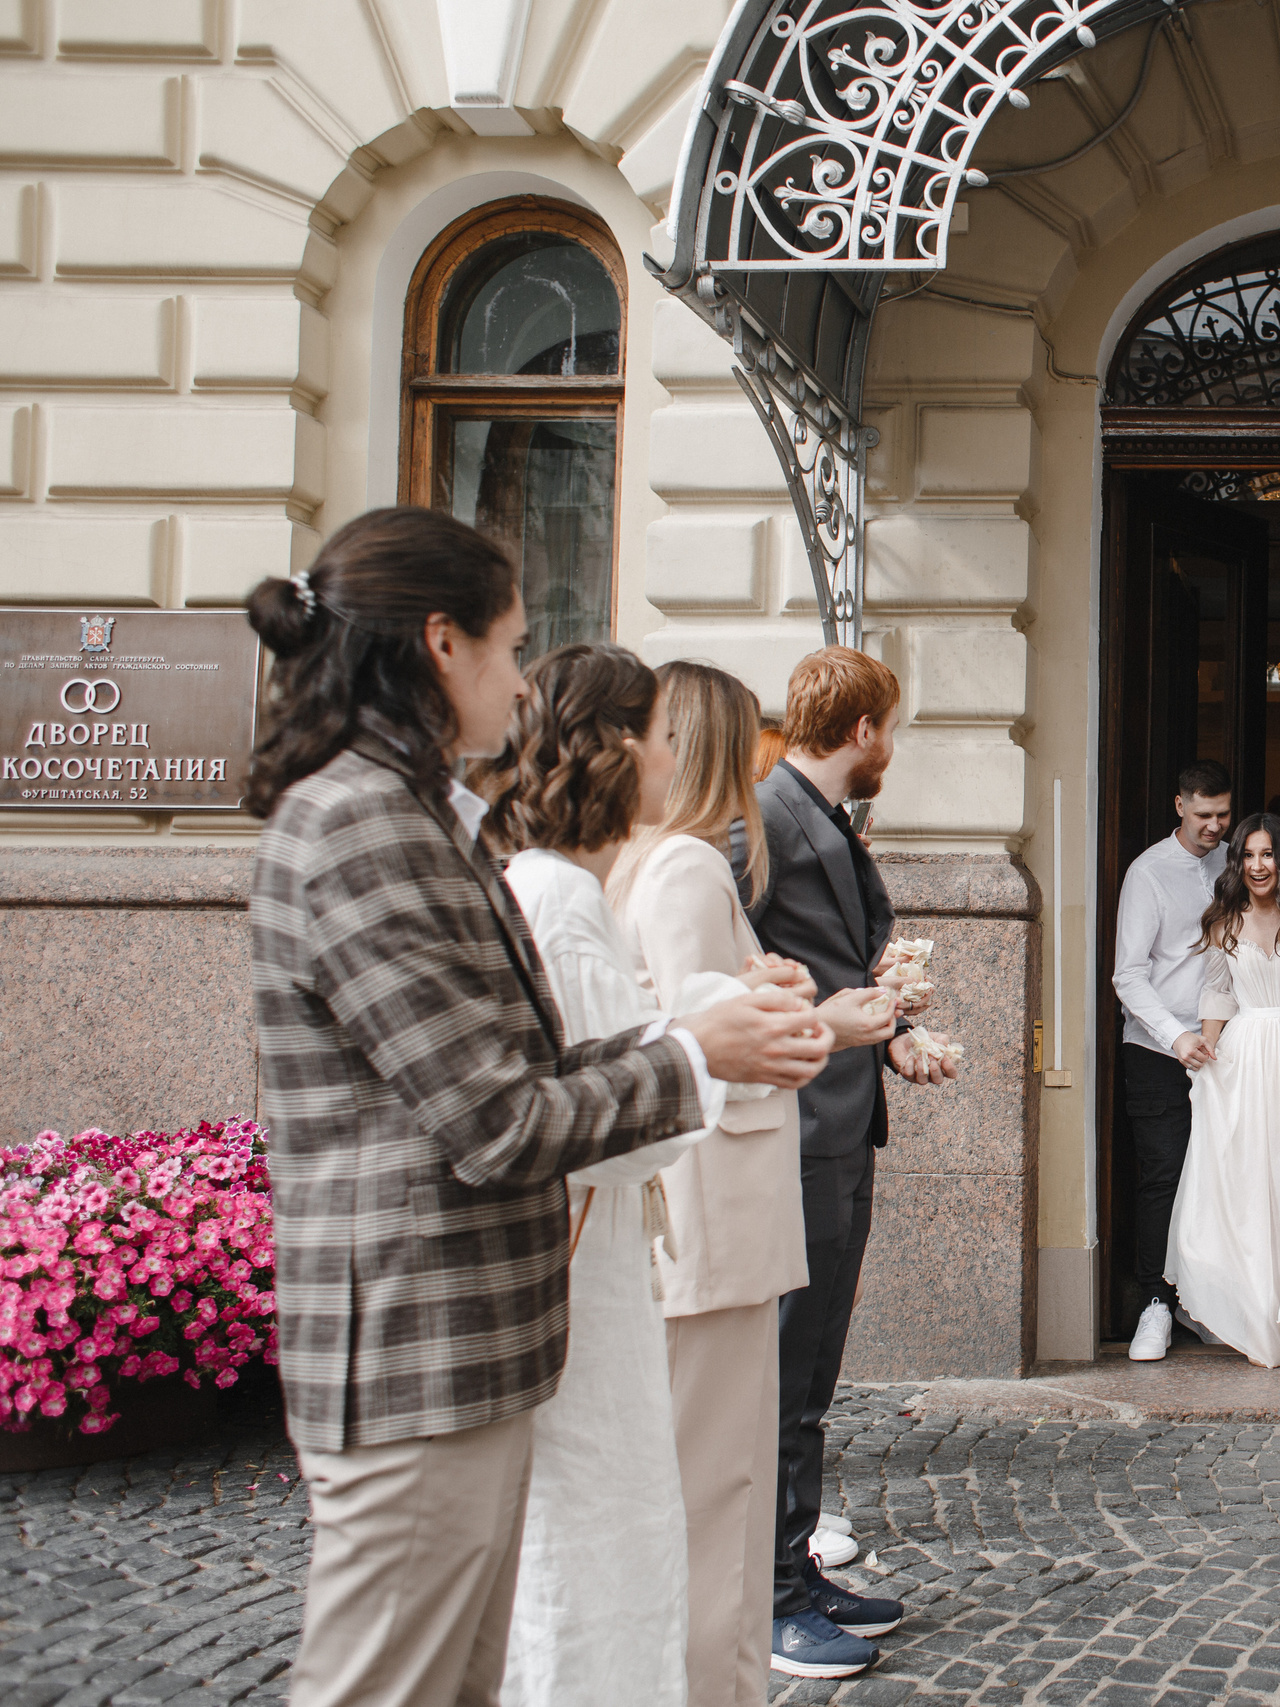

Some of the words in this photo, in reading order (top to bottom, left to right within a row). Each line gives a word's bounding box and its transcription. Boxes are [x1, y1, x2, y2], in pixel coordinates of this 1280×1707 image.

[25, 722, 150, 749] ДВОРЕЦ
[0, 757, 227, 782] КОСОЧЕТАНИЯ
[129, 787, 148, 800] 52
